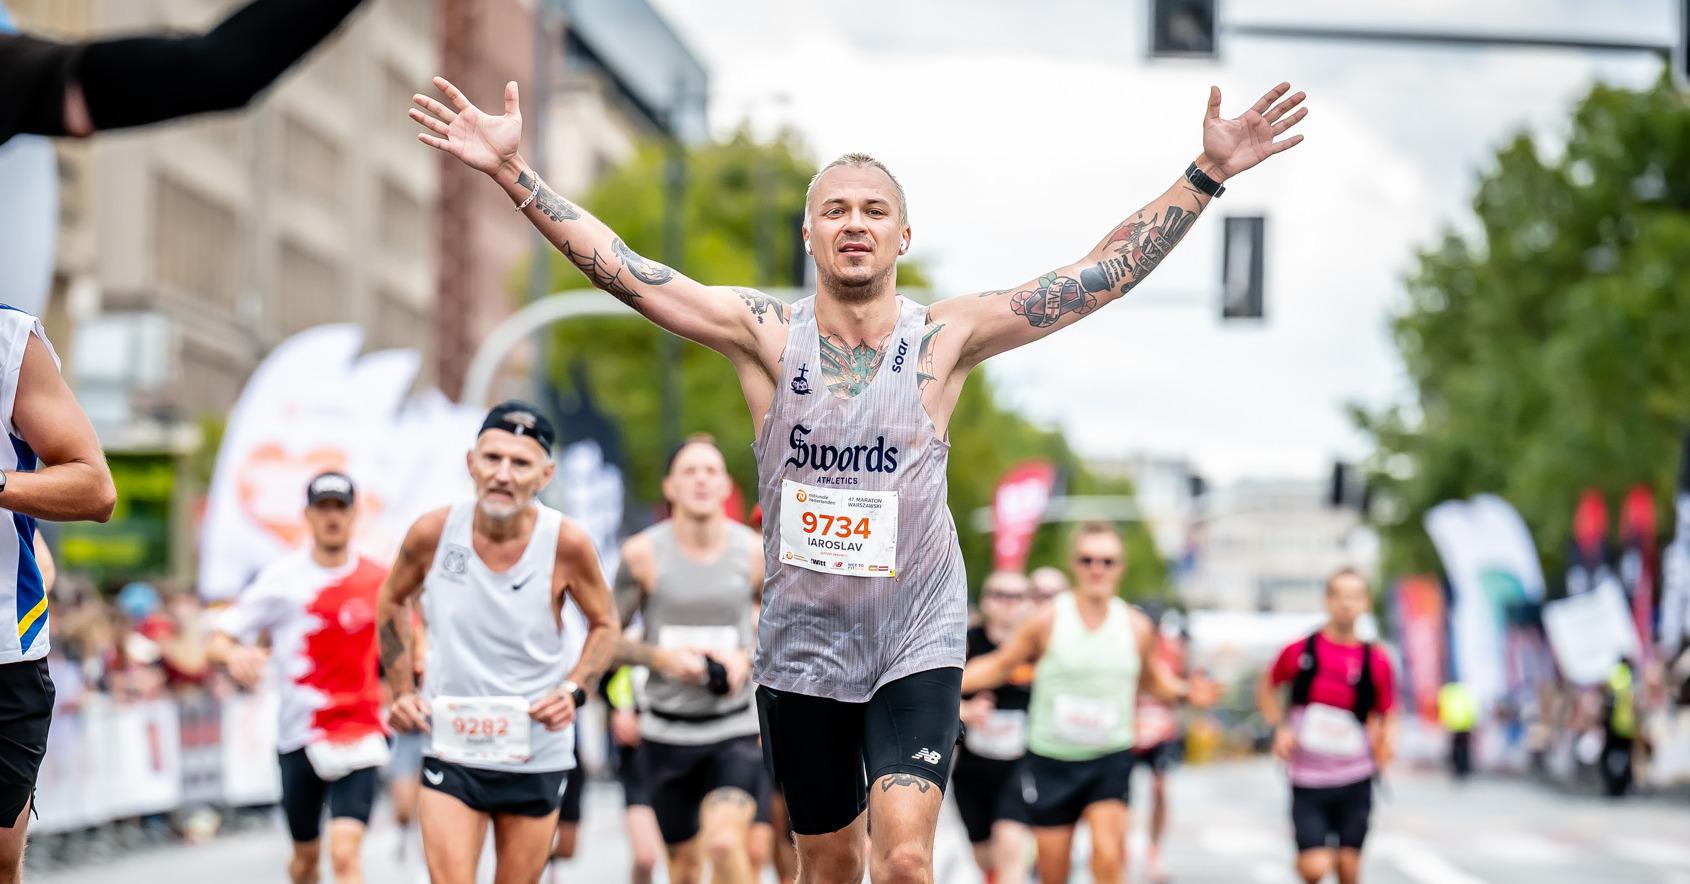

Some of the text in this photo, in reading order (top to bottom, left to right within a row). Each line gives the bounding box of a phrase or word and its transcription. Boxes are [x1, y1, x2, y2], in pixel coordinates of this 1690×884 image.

[892, 337, 909, 374] soar
[785, 424, 898, 473] Swords
[817, 476, 858, 485] ATHLETICS
[801, 511, 871, 539] 9734
[807, 537, 863, 552] IAROSLAV
[451, 716, 509, 737] 9282
